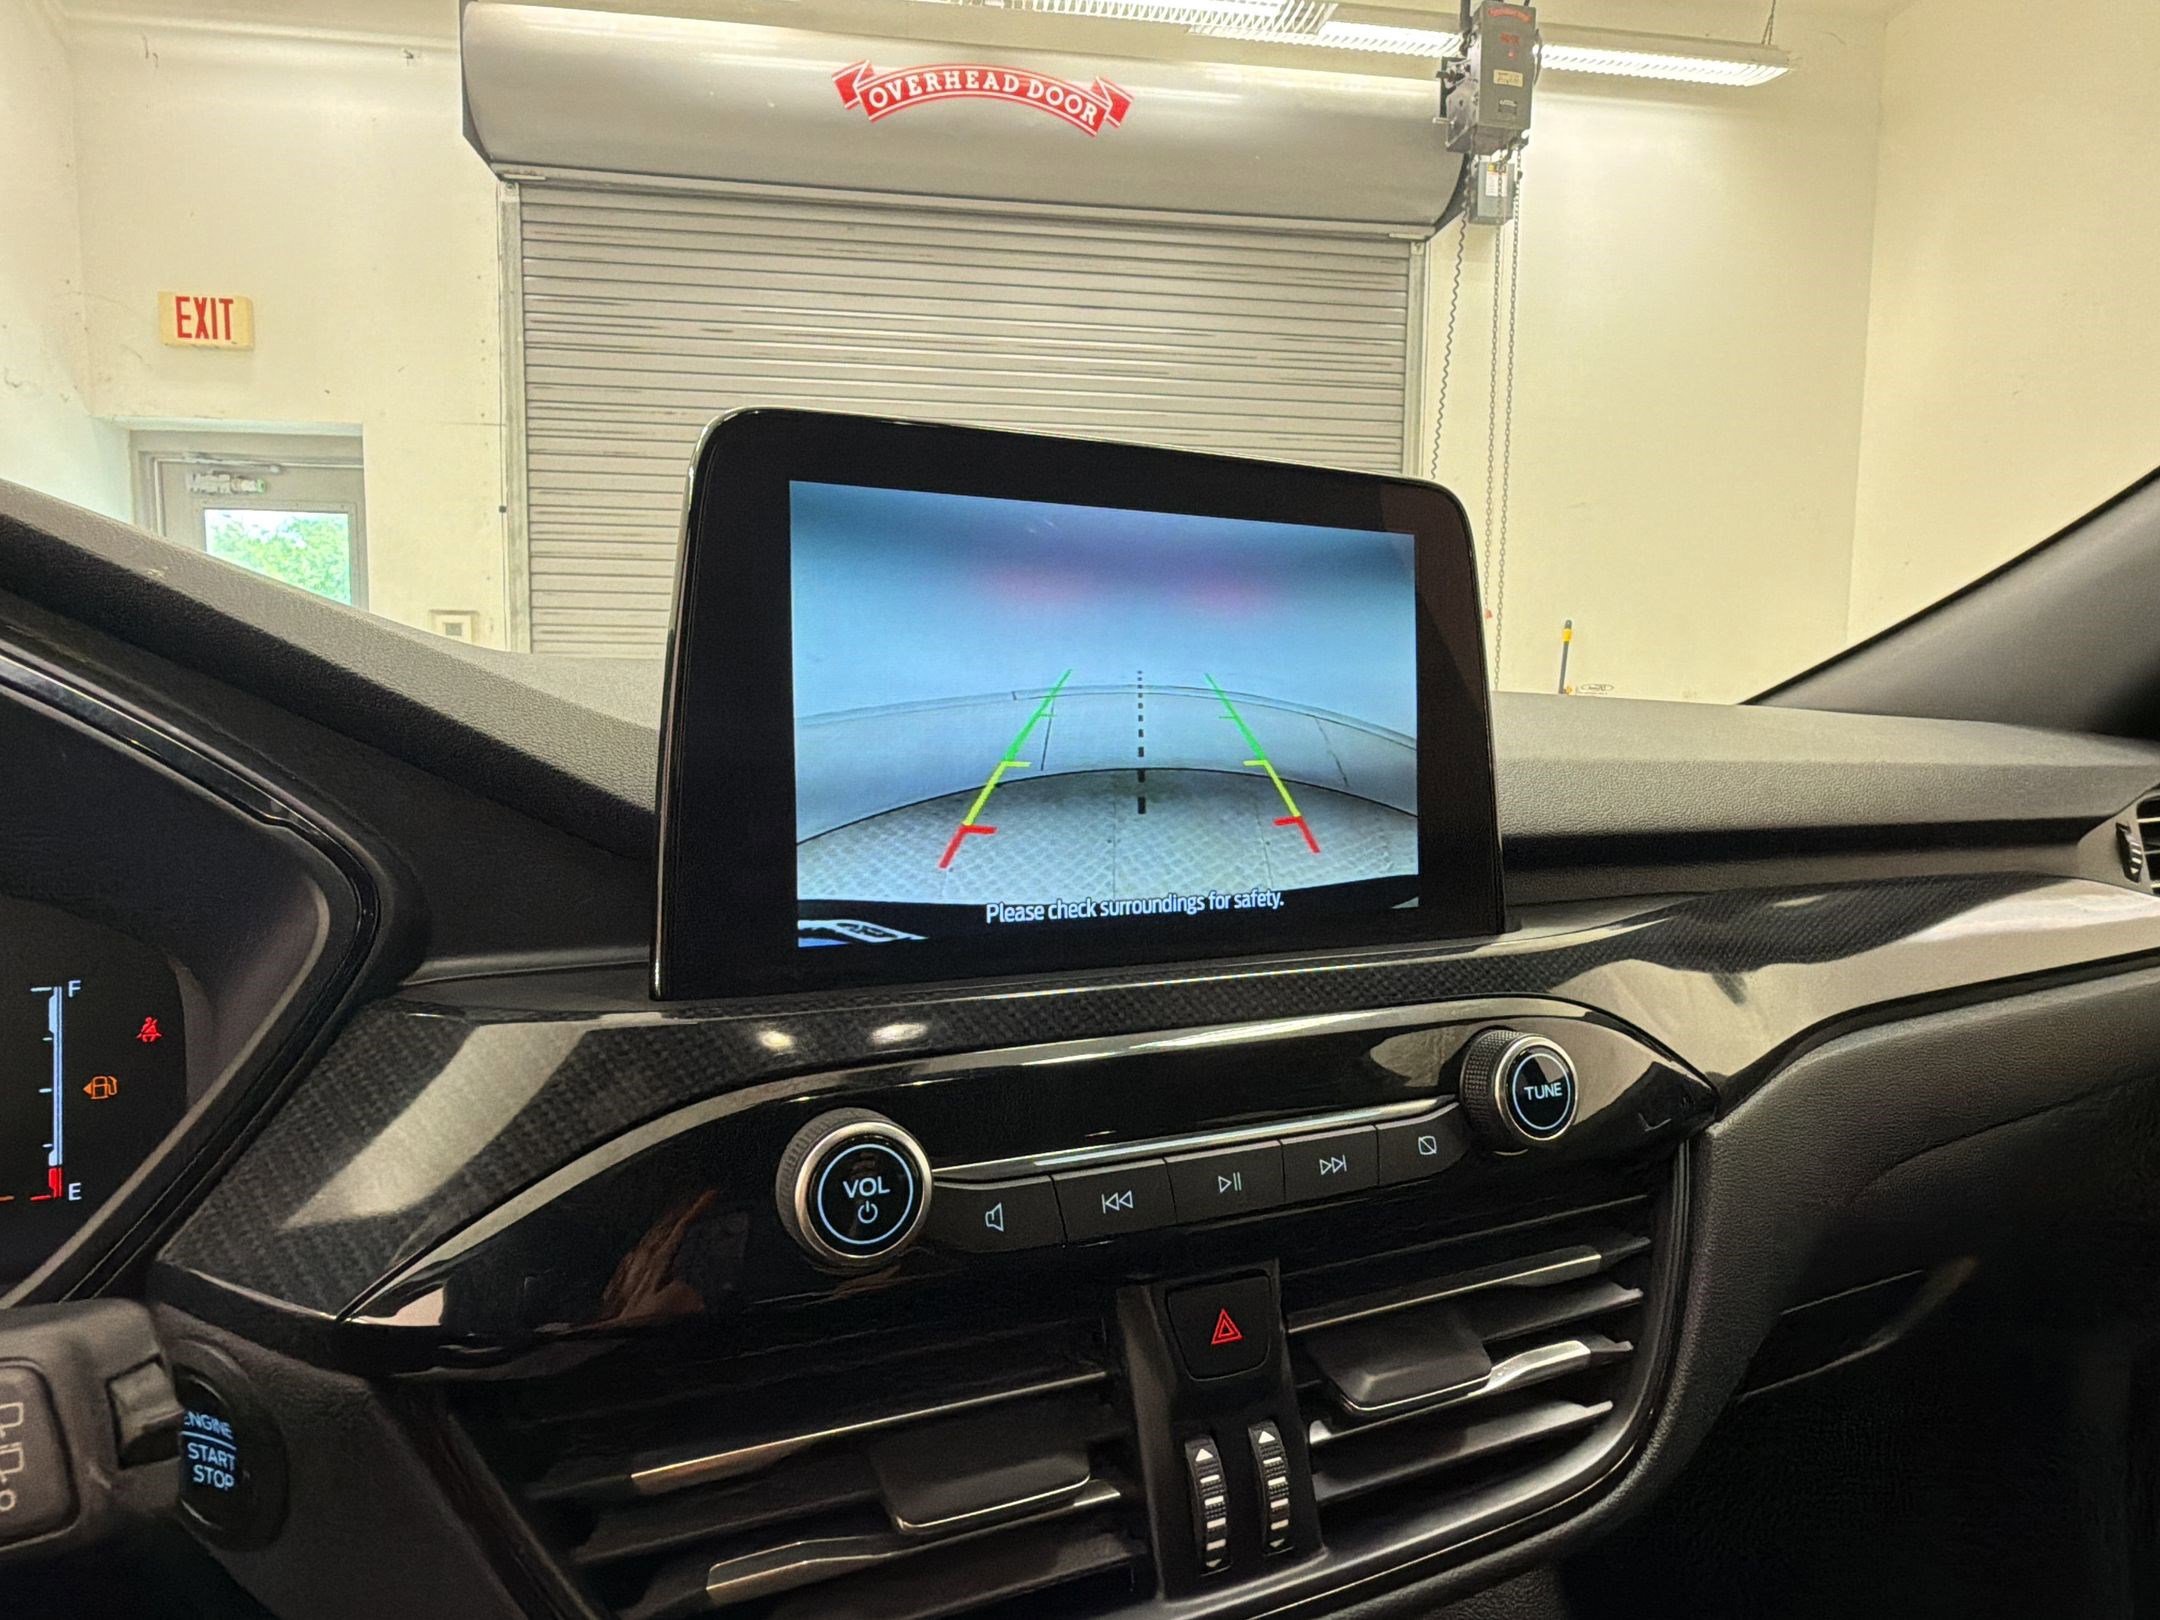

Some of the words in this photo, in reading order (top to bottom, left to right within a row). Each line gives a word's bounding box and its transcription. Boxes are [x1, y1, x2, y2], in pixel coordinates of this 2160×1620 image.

[869, 69, 1020, 109] OVERHEAD
[1026, 79, 1099, 126] DOOR
[175, 296, 234, 341] EXIT
[986, 902, 1045, 924] Please
[1048, 898, 1098, 920] check
[1100, 892, 1205, 916] surroundings
[1207, 890, 1232, 910] for
[1233, 888, 1285, 911] safety.
[68, 980, 82, 998] F
[1524, 1082, 1563, 1101] TUNE
[68, 1182, 82, 1201] E
[843, 1176, 891, 1199] VOL
[187, 1442, 236, 1472] START
[193, 1464, 235, 1491] STOP
